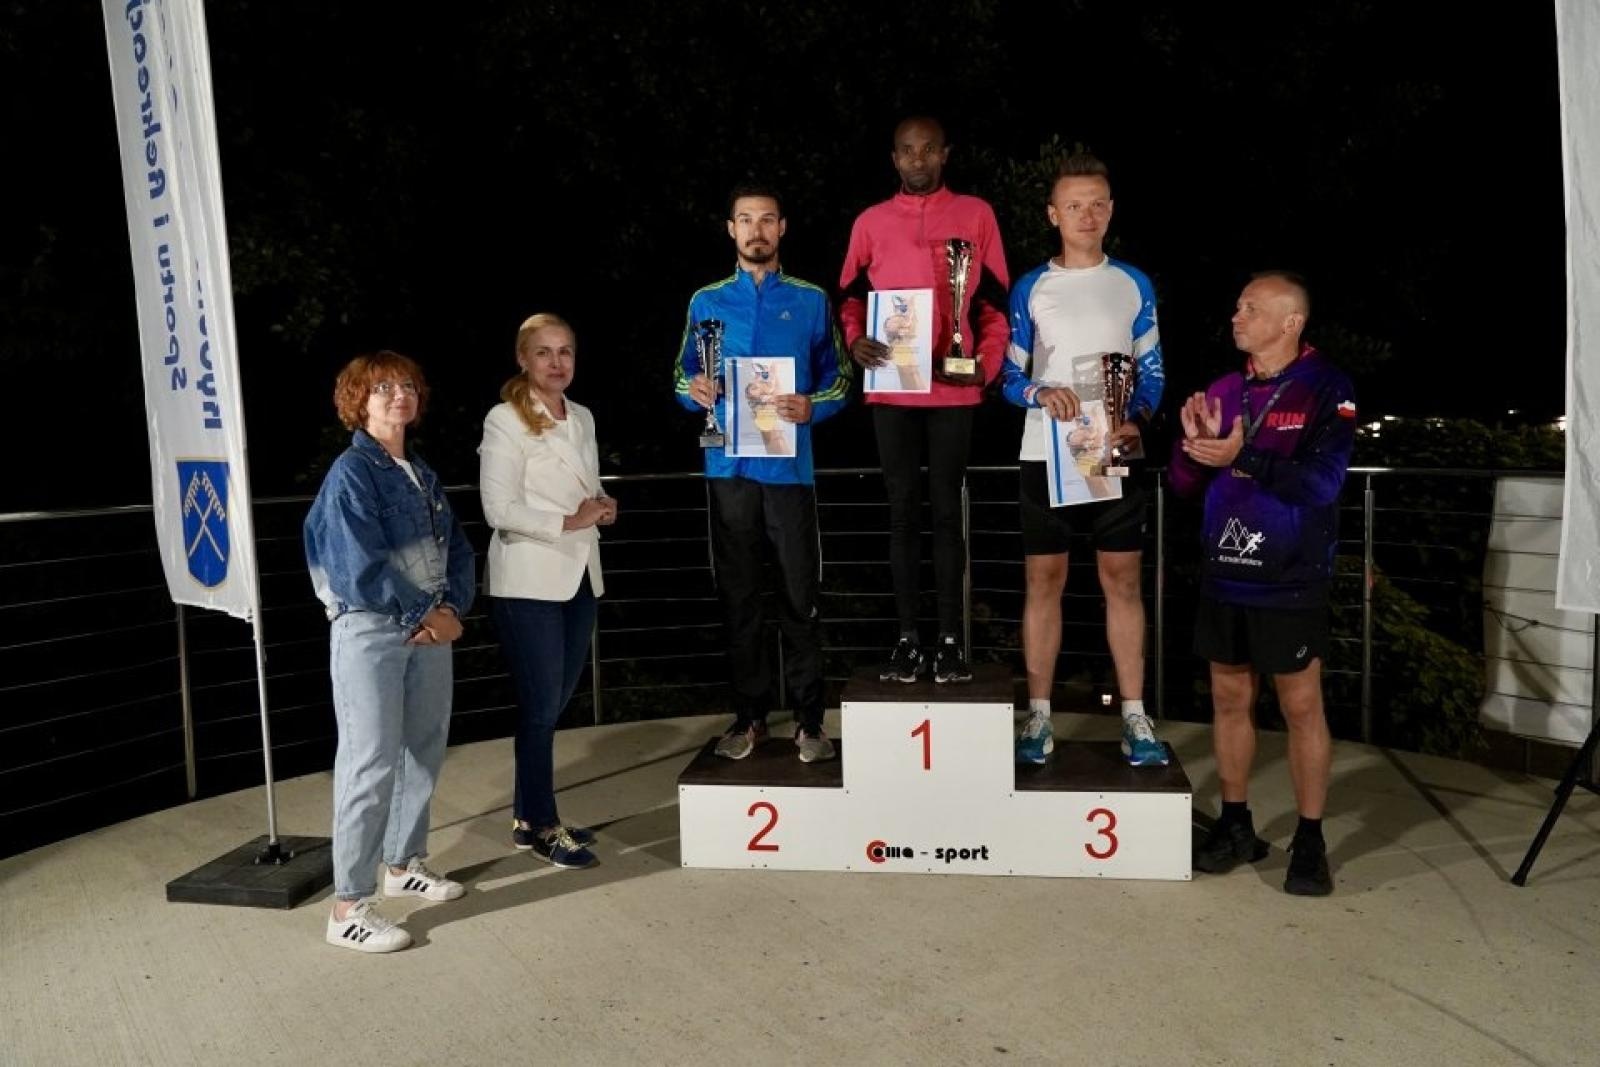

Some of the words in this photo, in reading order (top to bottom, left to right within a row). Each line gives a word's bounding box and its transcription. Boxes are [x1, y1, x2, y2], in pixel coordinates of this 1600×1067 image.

[1266, 411, 1306, 427] RUN
[911, 719, 931, 770] 1
[747, 801, 779, 851] 2
[1084, 808, 1119, 859] 3
[935, 844, 989, 864] sport
